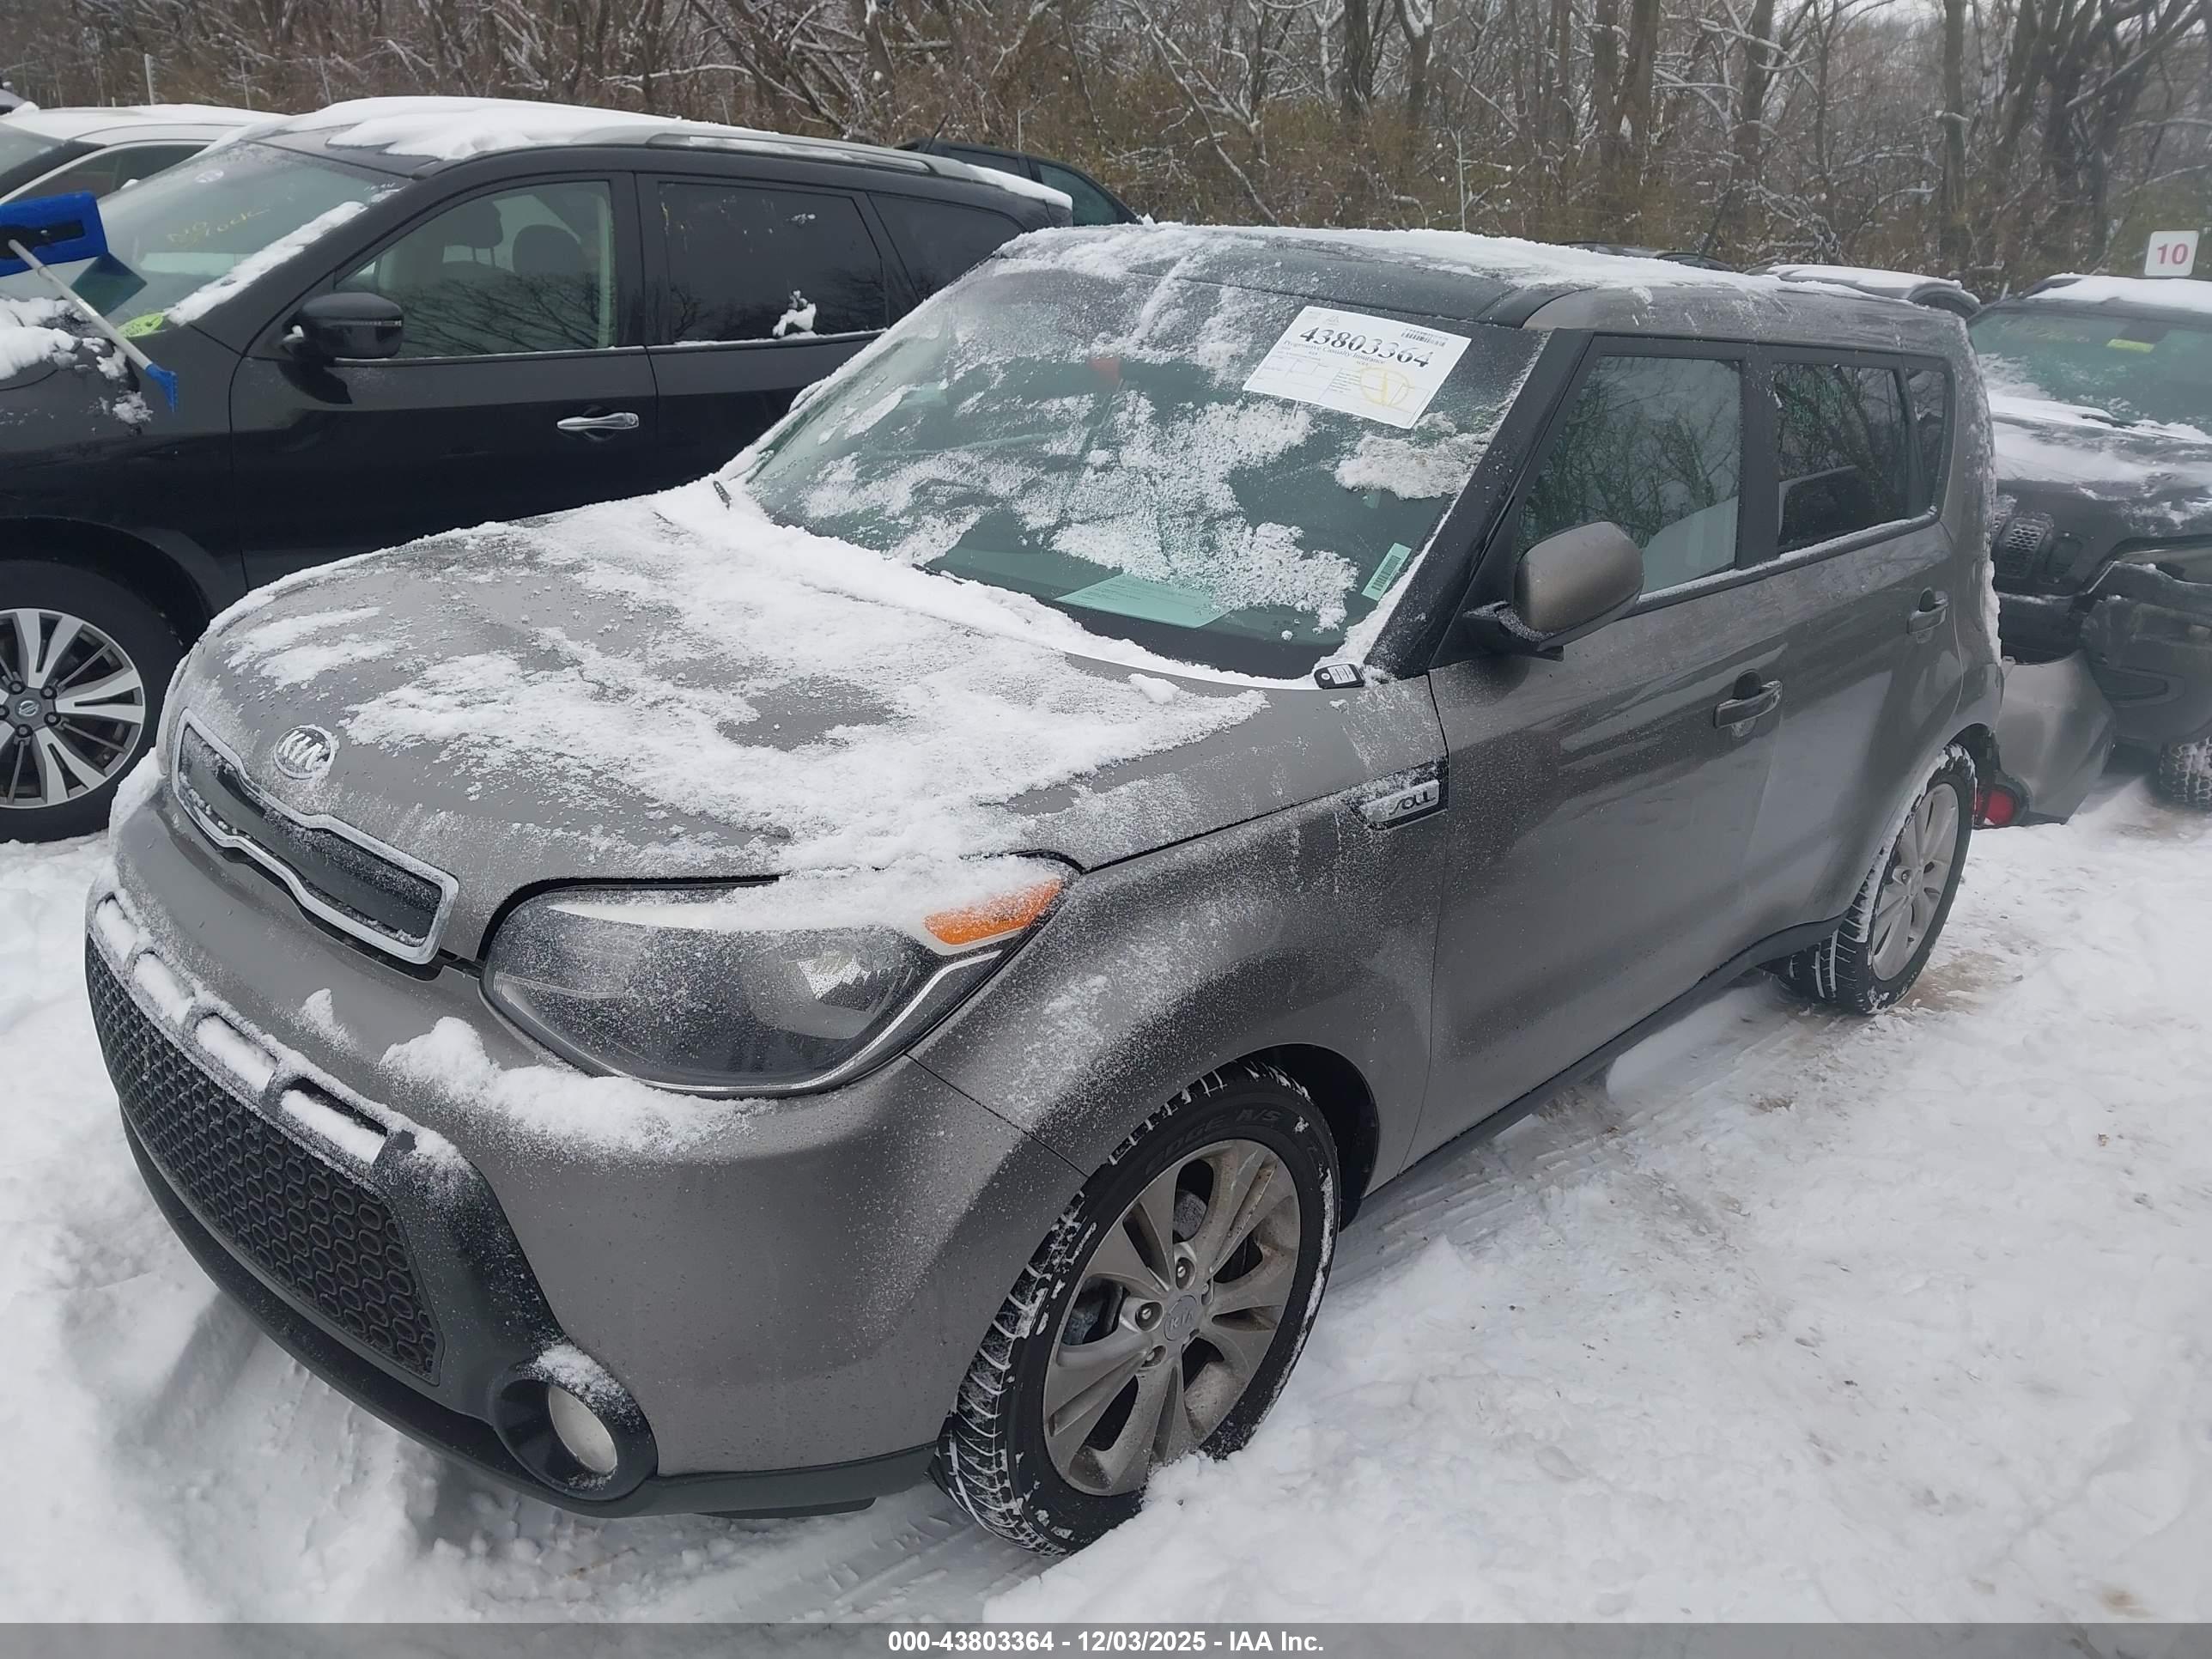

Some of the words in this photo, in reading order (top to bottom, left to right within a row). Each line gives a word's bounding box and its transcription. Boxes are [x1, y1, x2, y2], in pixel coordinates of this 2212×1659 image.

[2157, 243, 2189, 265] 10
[1298, 326, 1434, 368] 43803364
[1352, 352, 1387, 365] Insurance
[1389, 791, 1436, 815] SOUL
[1168, 1309, 1194, 1333] KIA
